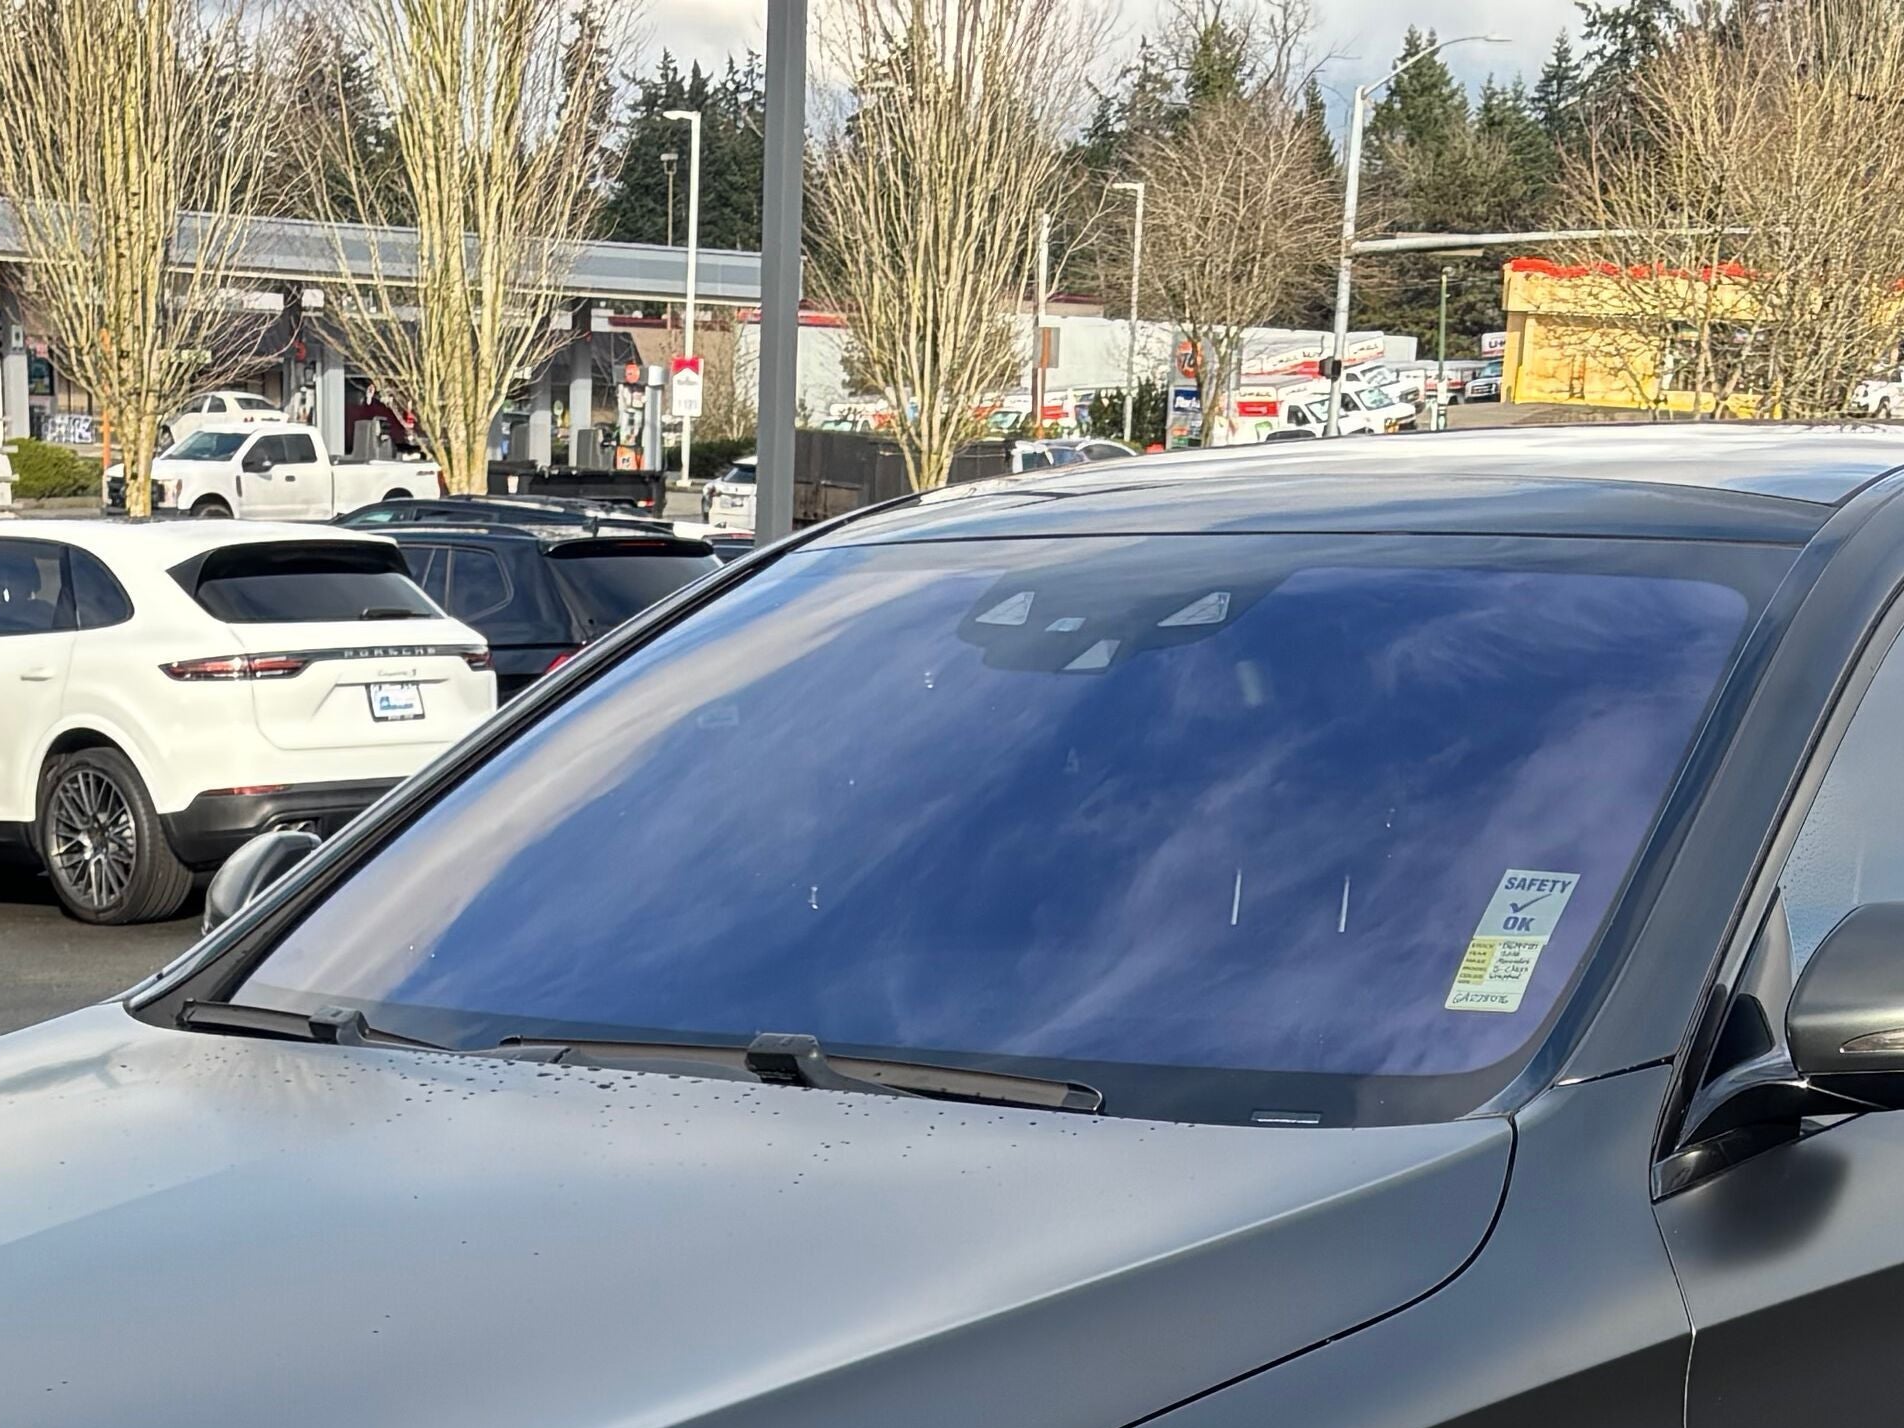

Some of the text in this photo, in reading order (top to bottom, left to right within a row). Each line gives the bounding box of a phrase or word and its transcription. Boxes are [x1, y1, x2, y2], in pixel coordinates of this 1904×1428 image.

[343, 647, 436, 659] PORSCHE
[1505, 877, 1572, 894] SAFETY
[1503, 916, 1536, 932] OK
